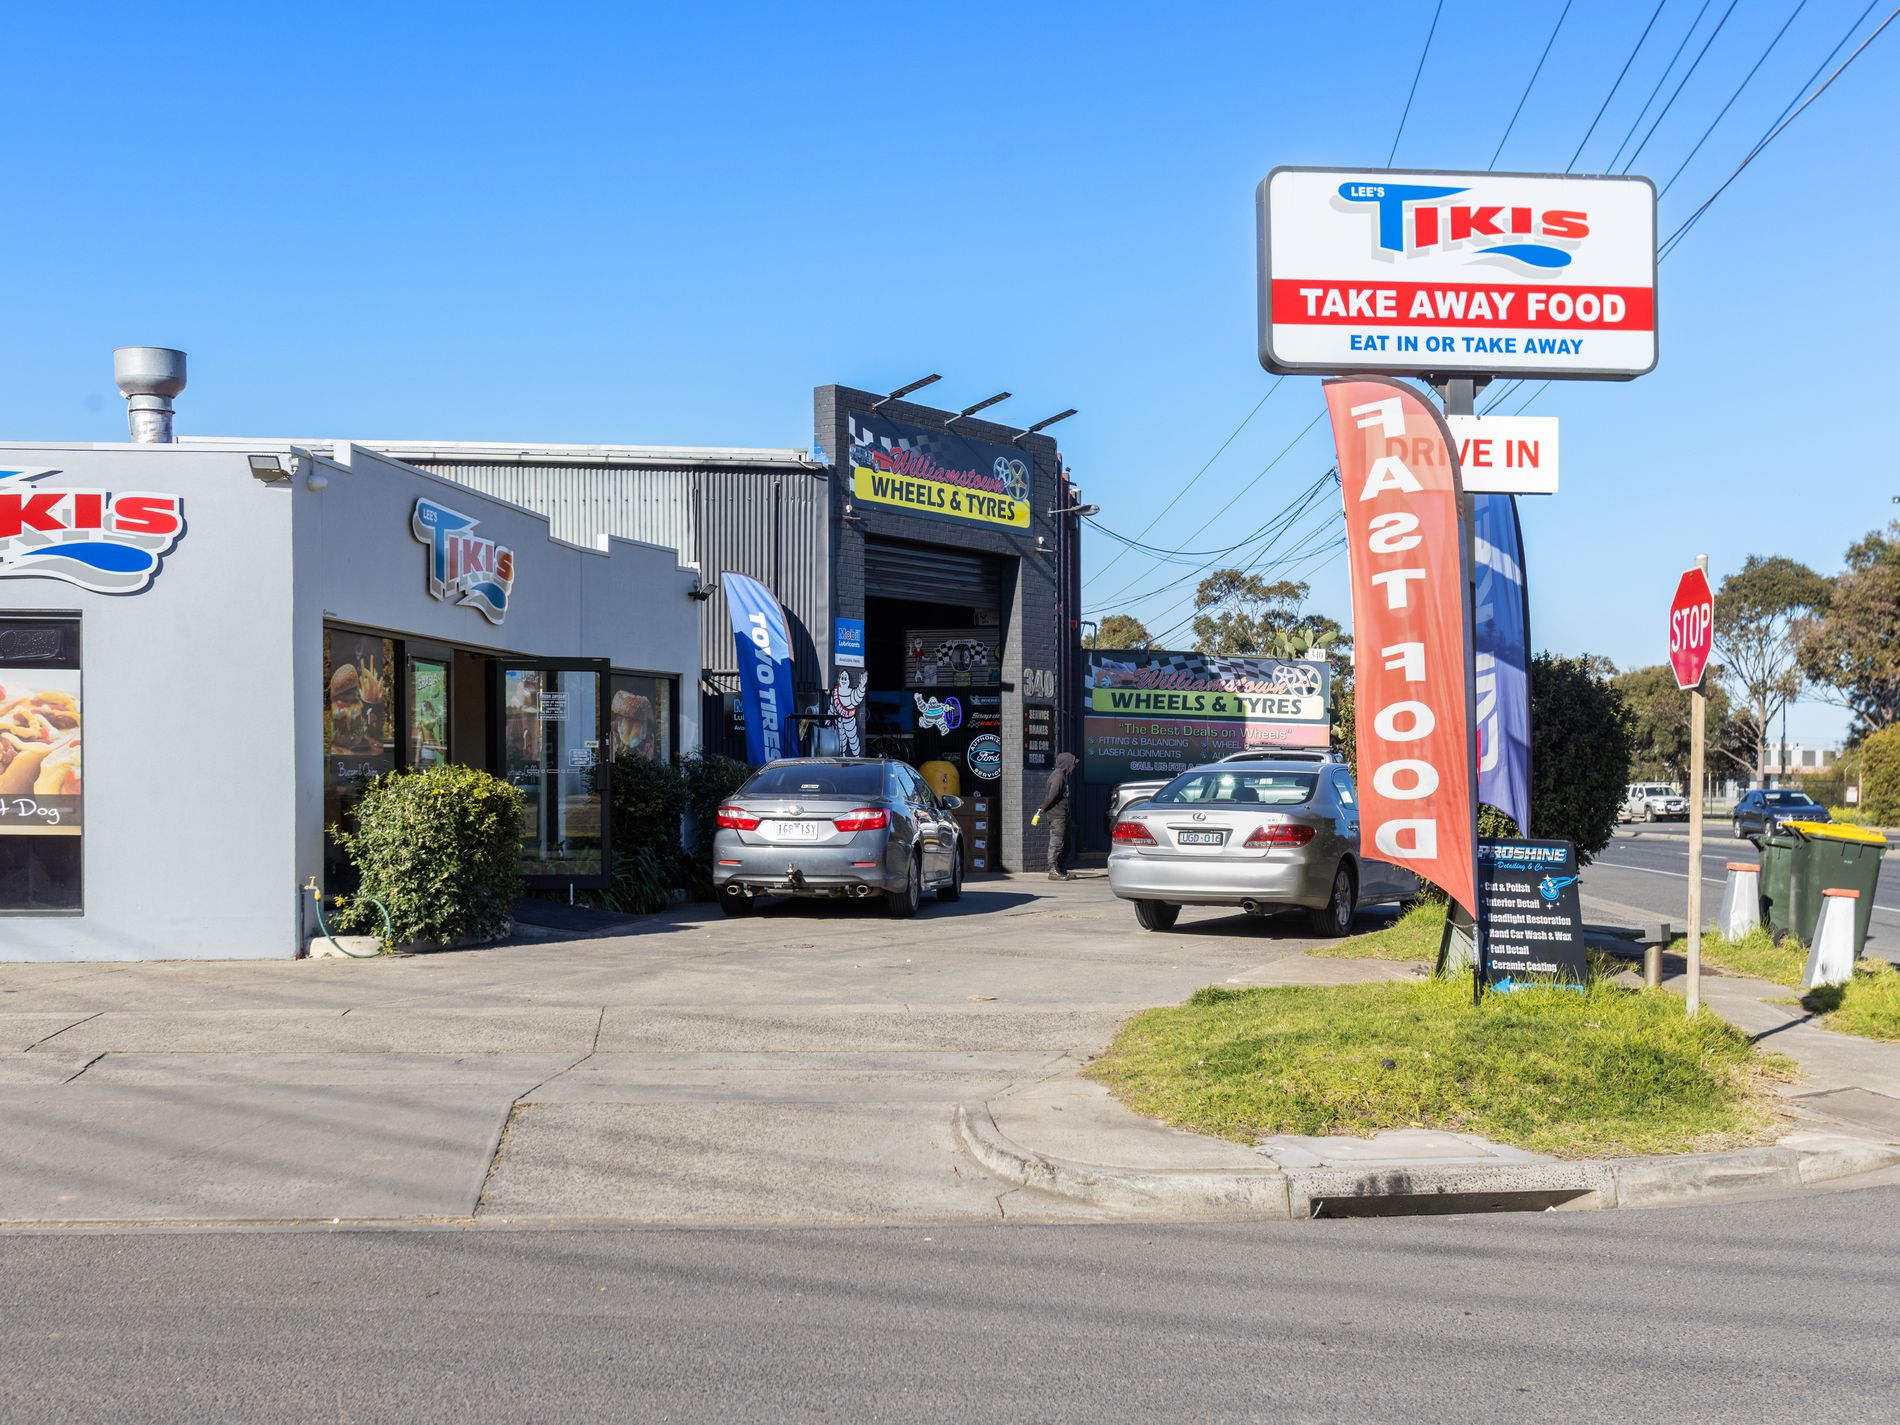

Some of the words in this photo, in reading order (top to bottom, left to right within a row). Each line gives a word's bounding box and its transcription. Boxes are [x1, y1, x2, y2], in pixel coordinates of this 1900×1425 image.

[1350, 185, 1385, 198] LEE'S
[1338, 181, 1591, 253] TIKIS
[1299, 287, 1398, 319] TAKE
[1408, 290, 1516, 322] AWAY
[1527, 292, 1626, 324] FOOD
[1349, 334, 1390, 352] EAT
[1397, 335, 1419, 353] IN
[1425, 336, 1456, 354] OR
[1461, 336, 1517, 354] TAKE
[1523, 337, 1584, 355] AWAY
[1505, 439, 1540, 469] IN
[889, 446, 1006, 494] Williamstown
[871, 475, 946, 508] WHEELS
[949, 490, 962, 512] &
[965, 493, 1016, 521] TYRES
[422, 508, 438, 522] LEE'S
[417, 502, 514, 583] TIKIS
[839, 628, 861, 641] Mobil
[1671, 602, 1711, 653] STOP
[748, 611, 775, 685] TOYO
[838, 640, 861, 649] Lubricants
[1023, 668, 1055, 698] 340
[1111, 692, 1206, 712] WHEELS
[1211, 695, 1228, 713] &
[1233, 696, 1302, 715] TYRES
[1028, 709, 1050, 720] SERVICE
[759, 688, 782, 763] TIRES
[1028, 724, 1049, 735] BRAKES
[1151, 724, 1180, 736] Best
[1183, 725, 1218, 737] Deals
[1221, 728, 1236, 738] on
[1098, 736, 1130, 746] FITTING
[1131, 737, 1138, 746] &
[1140, 737, 1189, 748] BALANCING
[976, 751, 1000, 762] Ford
[1098, 748, 1126, 757] LASER
[1127, 749, 1182, 759] ALIGNMENTS
[1130, 761, 1154, 771] CALL
[12, 798, 60, 825] Dog
[1477, 844, 1567, 863] PROSHINE
[1496, 861, 1525, 871] Detailing
[1527, 862, 1533, 871] &
[1485, 881, 1498, 892] Cut
[1499, 883, 1505, 892] &
[1505, 882, 1531, 893] Polish
[1486, 897, 1516, 908] Interior
[1516, 899, 1540, 909] Detail
[1487, 912, 1525, 924] Headlight
[1526, 914, 1572, 926] Restoration
[1489, 928, 1509, 939] Hand
[1510, 929, 1524, 939] Car
[1524, 930, 1547, 940] Wash
[1548, 932, 1554, 941] &
[1554, 931, 1573, 941] Wax
[1490, 944, 1505, 954] Full
[1505, 944, 1530, 955] Detail
[1491, 959, 1526, 971] Ceramic
[1526, 961, 1558, 973] Coating
